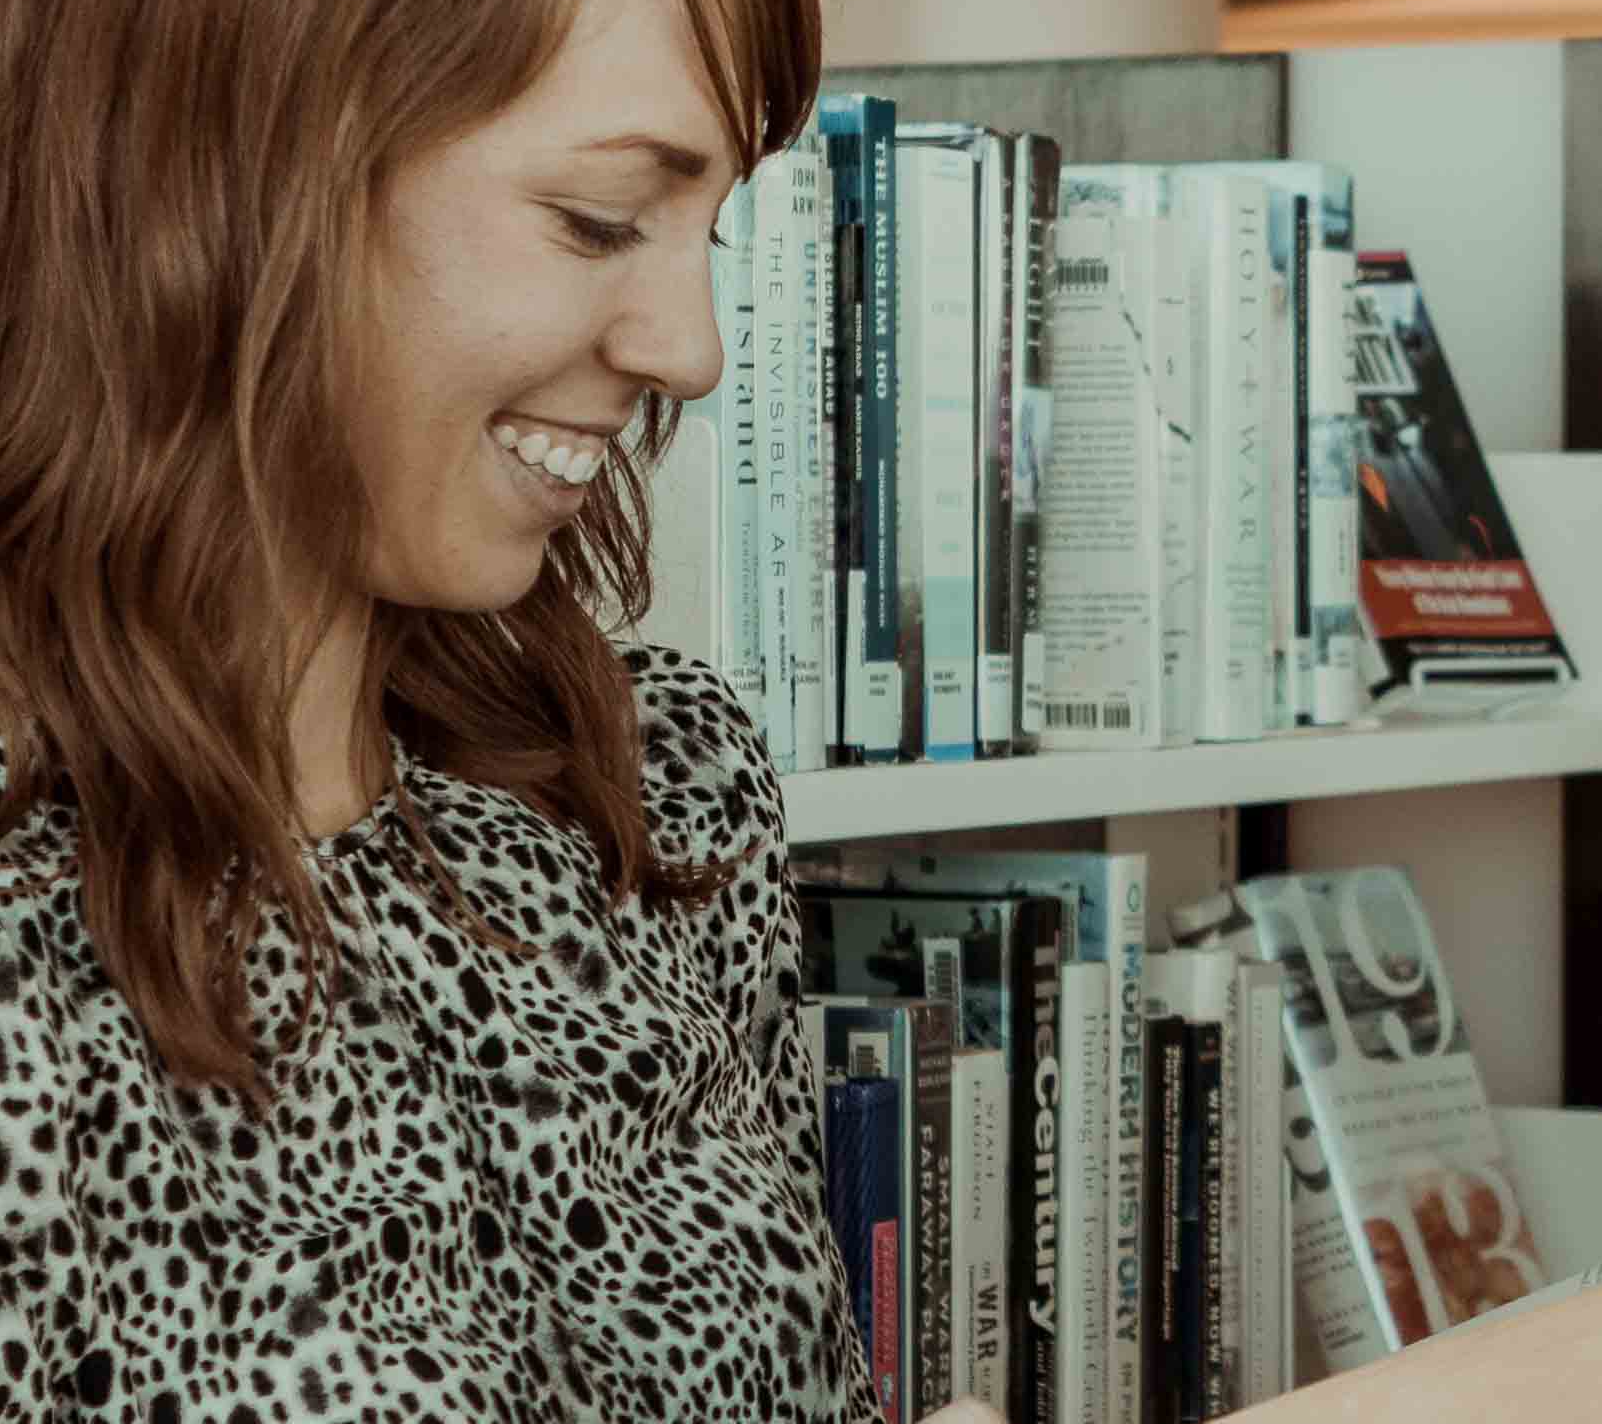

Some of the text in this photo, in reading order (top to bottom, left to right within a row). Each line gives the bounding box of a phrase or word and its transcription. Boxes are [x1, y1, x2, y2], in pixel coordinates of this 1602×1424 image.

[766, 232, 786, 513] THE INVISIBLE
[873, 136, 890, 400] THE MUSLIM 100
[918, 1124, 935, 1406] FARAWAY PLAC
[936, 1154, 951, 1281] SMALL
[1029, 943, 1061, 1335] The Century
[1116, 943, 1143, 1345] MODERN HISTORY
[976, 1284, 1000, 1362] WAR
